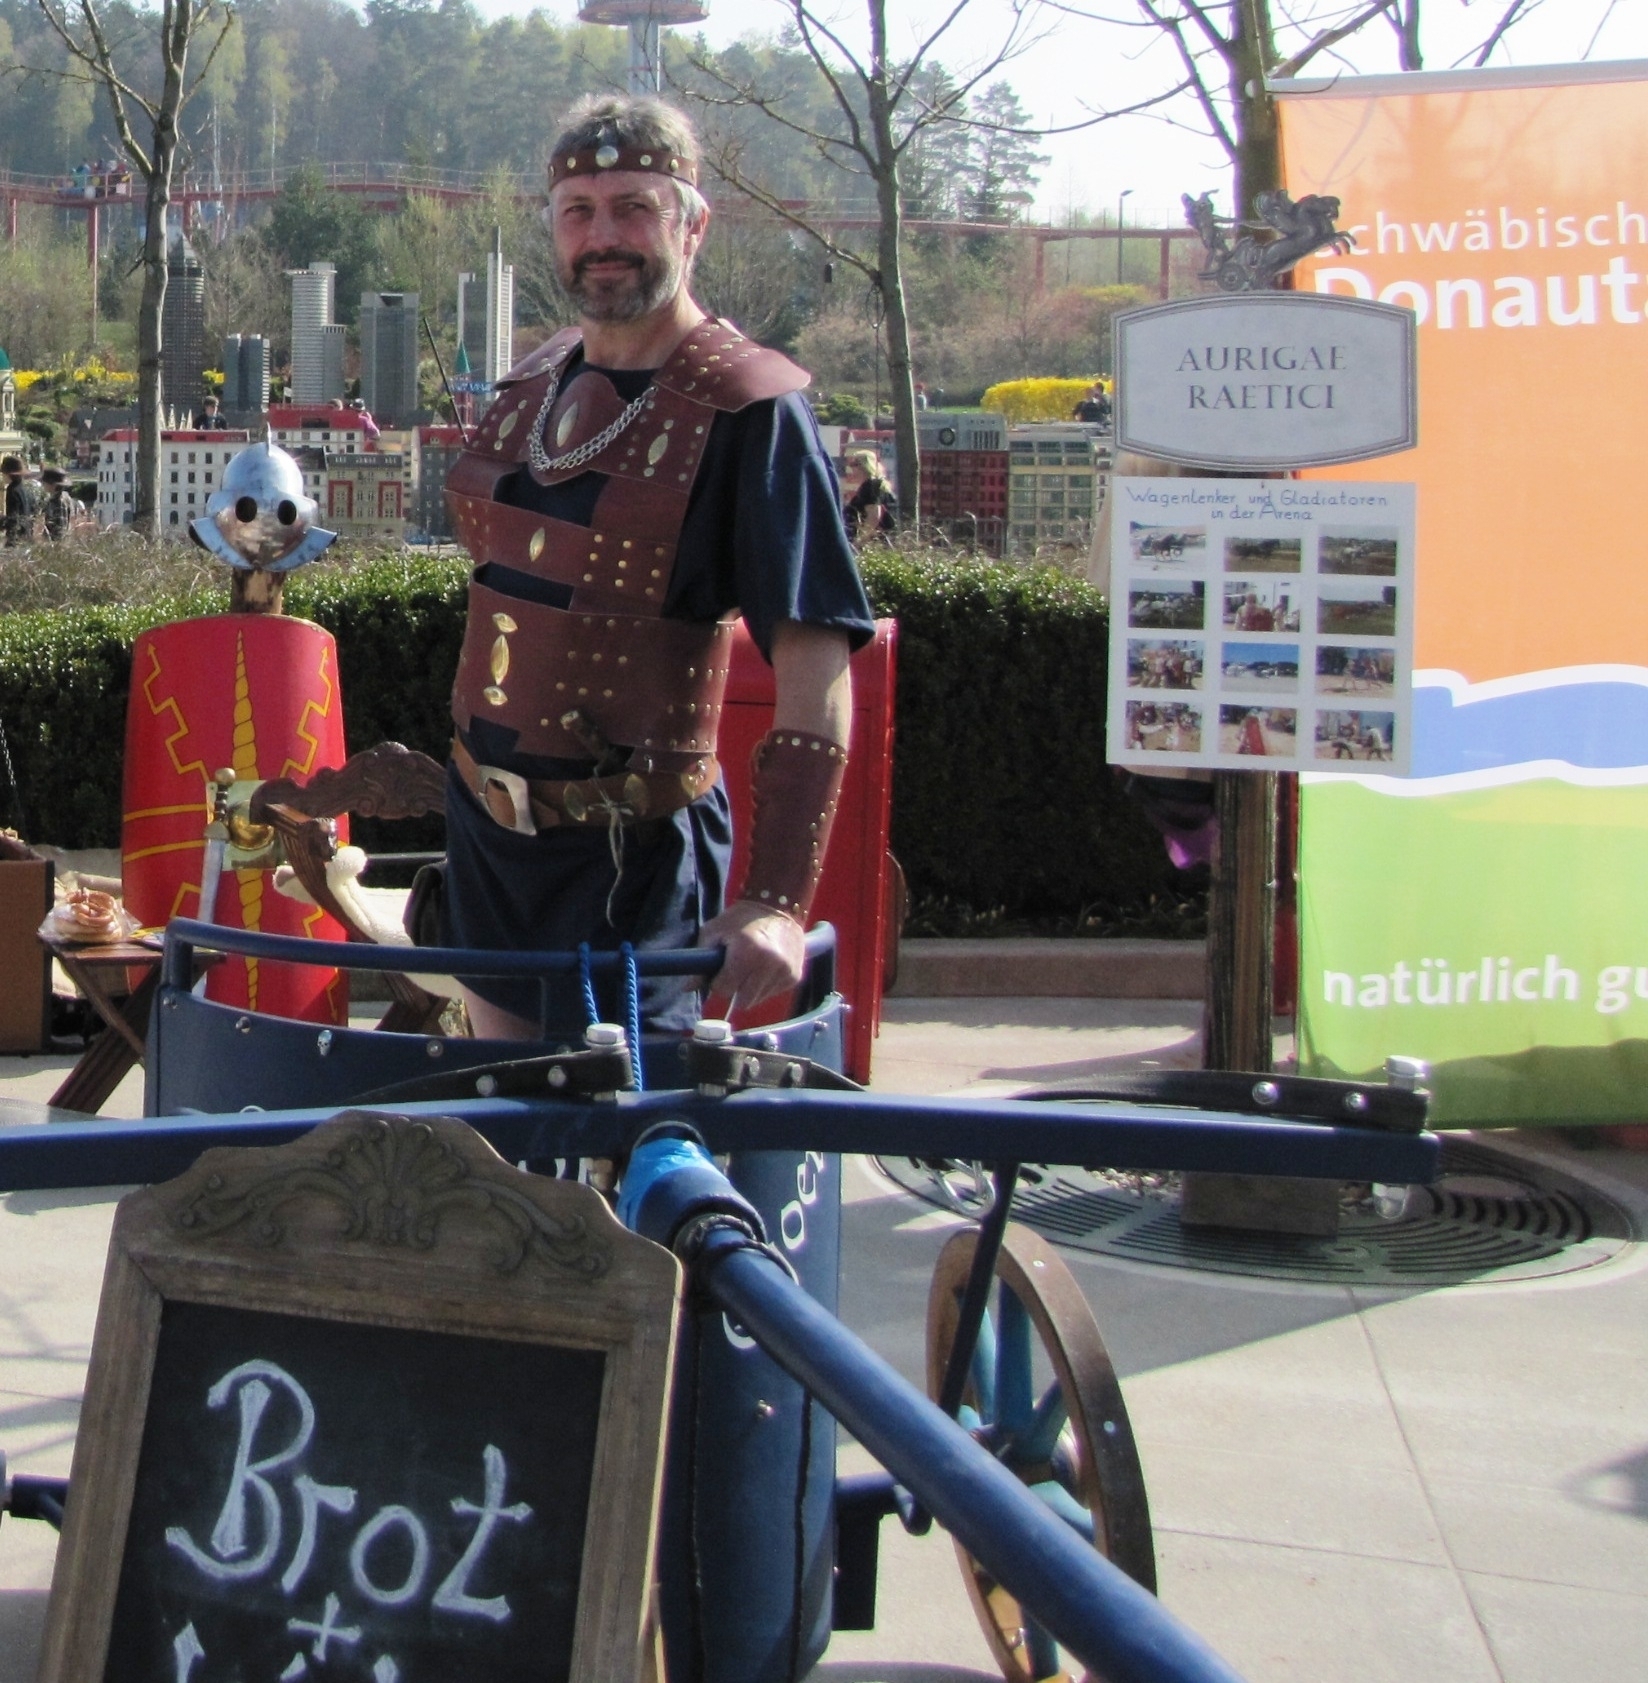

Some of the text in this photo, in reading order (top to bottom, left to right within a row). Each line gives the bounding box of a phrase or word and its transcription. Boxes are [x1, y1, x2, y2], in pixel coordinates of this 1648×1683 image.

[1313, 201, 1648, 258] chwäbisch
[1176, 345, 1348, 371] AURIGAE
[1188, 383, 1336, 410] RAETICI
[1126, 487, 1388, 506] Wagenlenker und Gladiatoren
[1211, 501, 1314, 520] in der Arena
[1323, 954, 1580, 1007] natürlich
[165, 1358, 533, 1621] Brot
